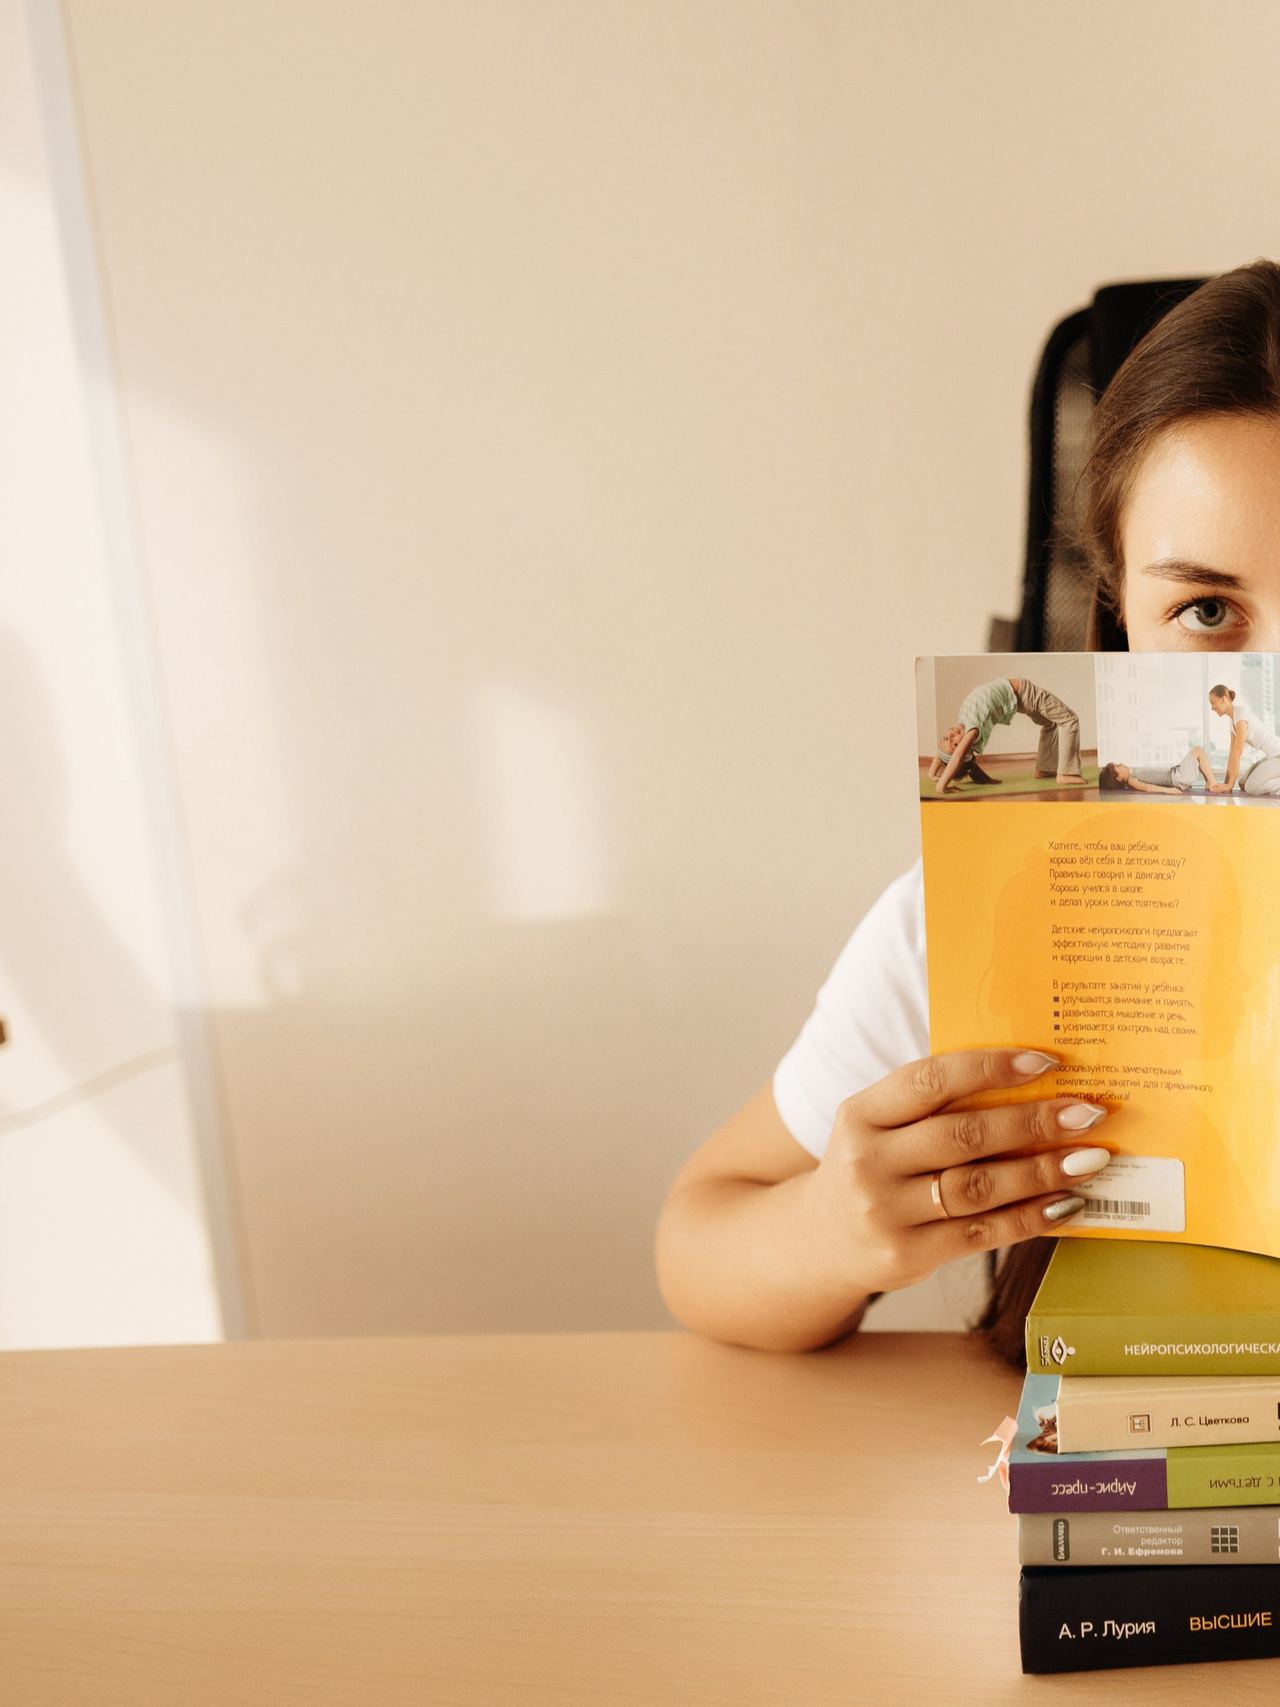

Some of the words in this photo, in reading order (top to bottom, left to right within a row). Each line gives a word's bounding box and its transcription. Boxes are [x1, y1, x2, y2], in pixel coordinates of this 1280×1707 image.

[1049, 841, 1081, 851] Хотите,
[1084, 841, 1108, 850] чтобы
[1111, 842, 1125, 851] ваш
[1128, 842, 1159, 853] ребёнок
[1049, 856, 1076, 866] хорошо
[1079, 856, 1093, 865] вёл
[1096, 856, 1114, 865] себя
[1125, 858, 1159, 866] детском
[1162, 857, 1186, 868] саду?
[1050, 869, 1090, 880] Правильно
[1093, 870, 1124, 880] говорил
[1135, 871, 1176, 880] двигался?
[1050, 883, 1079, 894] Хорошо
[1082, 885, 1109, 894] учился
[1120, 885, 1143, 893] школе
[1059, 899, 1082, 907] делал
[1084, 899, 1108, 909] уроки
[1111, 899, 1179, 909] самостоятельно?
[1052, 925, 1085, 935] Детские
[1088, 926, 1150, 936] нейропсихологи
[1153, 928, 1198, 938] предлагают
[1052, 939, 1108, 950] эффективную
[1111, 940, 1151, 951] методику
[1155, 942, 1190, 952] развития
[1061, 954, 1103, 964] коррекции
[1114, 955, 1148, 964] детском
[1151, 955, 1186, 966] возрасте.
[1053, 980, 1058, 989] В
[1061, 981, 1106, 991] результате
[1110, 982, 1141, 991] занятий
[1144, 984, 1149, 992] у
[1152, 982, 1185, 994] ребёнка:
[1062, 996, 1112, 1006] улучшаются
[1114, 997, 1153, 1005] внимание
[1163, 998, 1194, 1009] память,
[1062, 1009, 1114, 1019] развиваются
[1116, 1011, 1156, 1019] мышление
[1167, 1012, 1186, 1022] речь,
[1063, 1024, 1114, 1033] усиливается
[1117, 1024, 1152, 1034] контроль
[1155, 1026, 1169, 1034] над
[1172, 1027, 1196, 1035] своим
[1054, 1037, 1107, 1045] поведением.
[1056, 1078, 1105, 1087] комплексом
[1108, 1078, 1140, 1087] занятий
[1143, 1080, 1159, 1089] для
[1161, 1081, 1213, 1092] гармоничного
[1170, 1418, 1181, 1428] Л.
[1184, 1416, 1195, 1427] С.
[1198, 1414, 1250, 1427] Цветкова
[1051, 1477, 1137, 1496] Айрис-пресс
[1209, 1477, 1262, 1489] детьми
[1266, 1478, 1274, 1487] с
[1113, 1525, 1183, 1534] Ответственный
[1141, 1536, 1183, 1546] редактор
[1101, 1547, 1111, 1556] Г.
[1114, 1547, 1125, 1556] И.
[1128, 1546, 1183, 1558] Ефремова
[1189, 1612, 1273, 1631] ВЫСШИЕ
[1058, 1623, 1076, 1639] А.
[1080, 1623, 1098, 1638] Р.
[1102, 1620, 1156, 1640] Лурия
